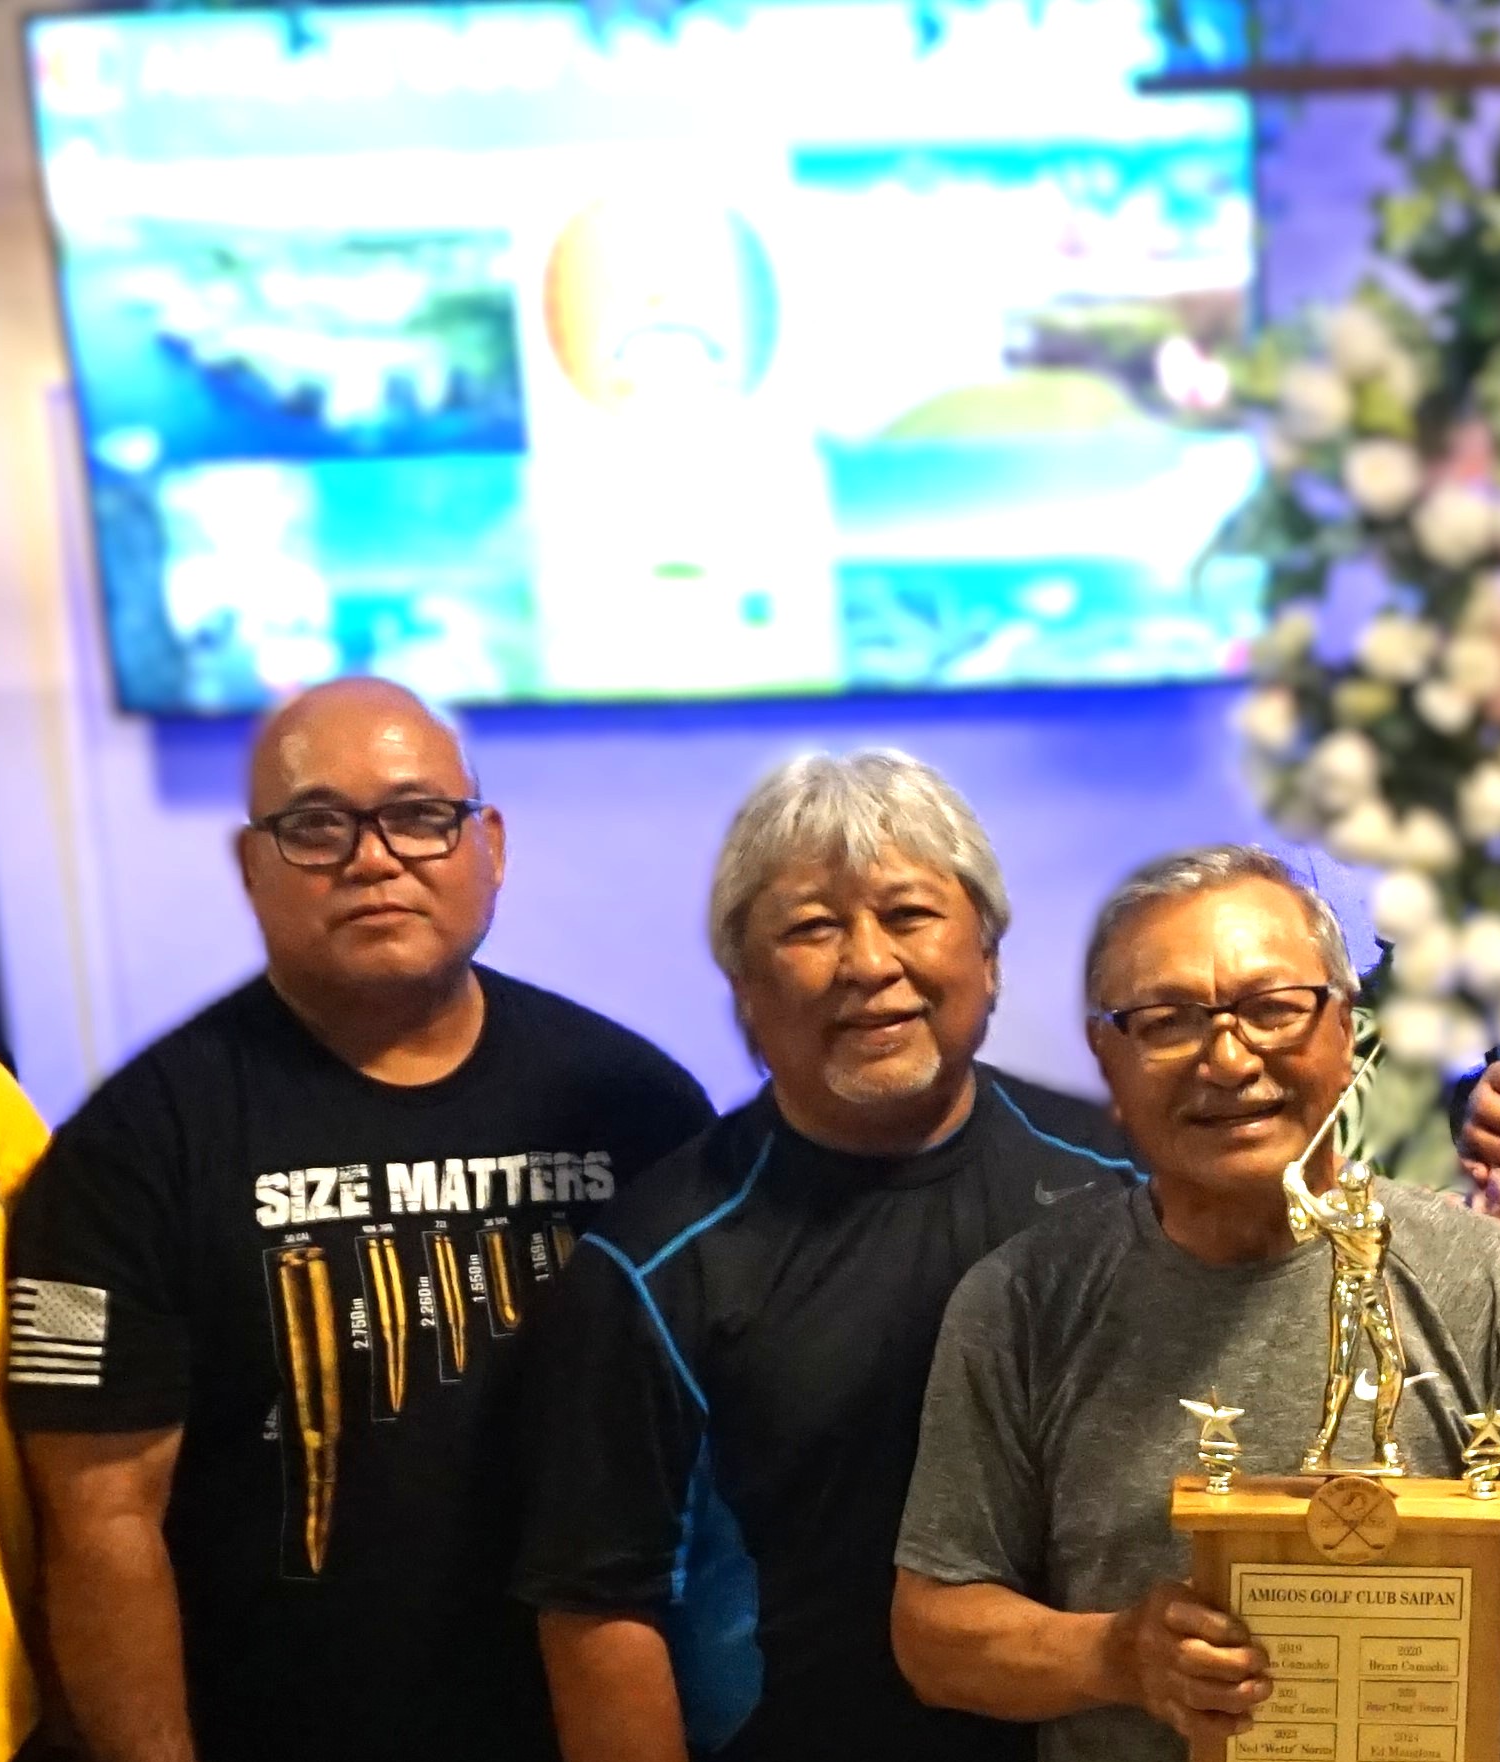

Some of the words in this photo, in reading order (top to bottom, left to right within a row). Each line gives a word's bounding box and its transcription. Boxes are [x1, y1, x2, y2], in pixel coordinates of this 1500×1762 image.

[255, 1163, 372, 1228] SIZE
[385, 1151, 615, 1213] MATTERS
[352, 1298, 370, 1349] 2.750in
[1249, 1588, 1306, 1603] AMIGOS
[1310, 1590, 1354, 1604] GOLF
[1356, 1590, 1397, 1605] CLUB
[1400, 1591, 1456, 1606] SAIPAN
